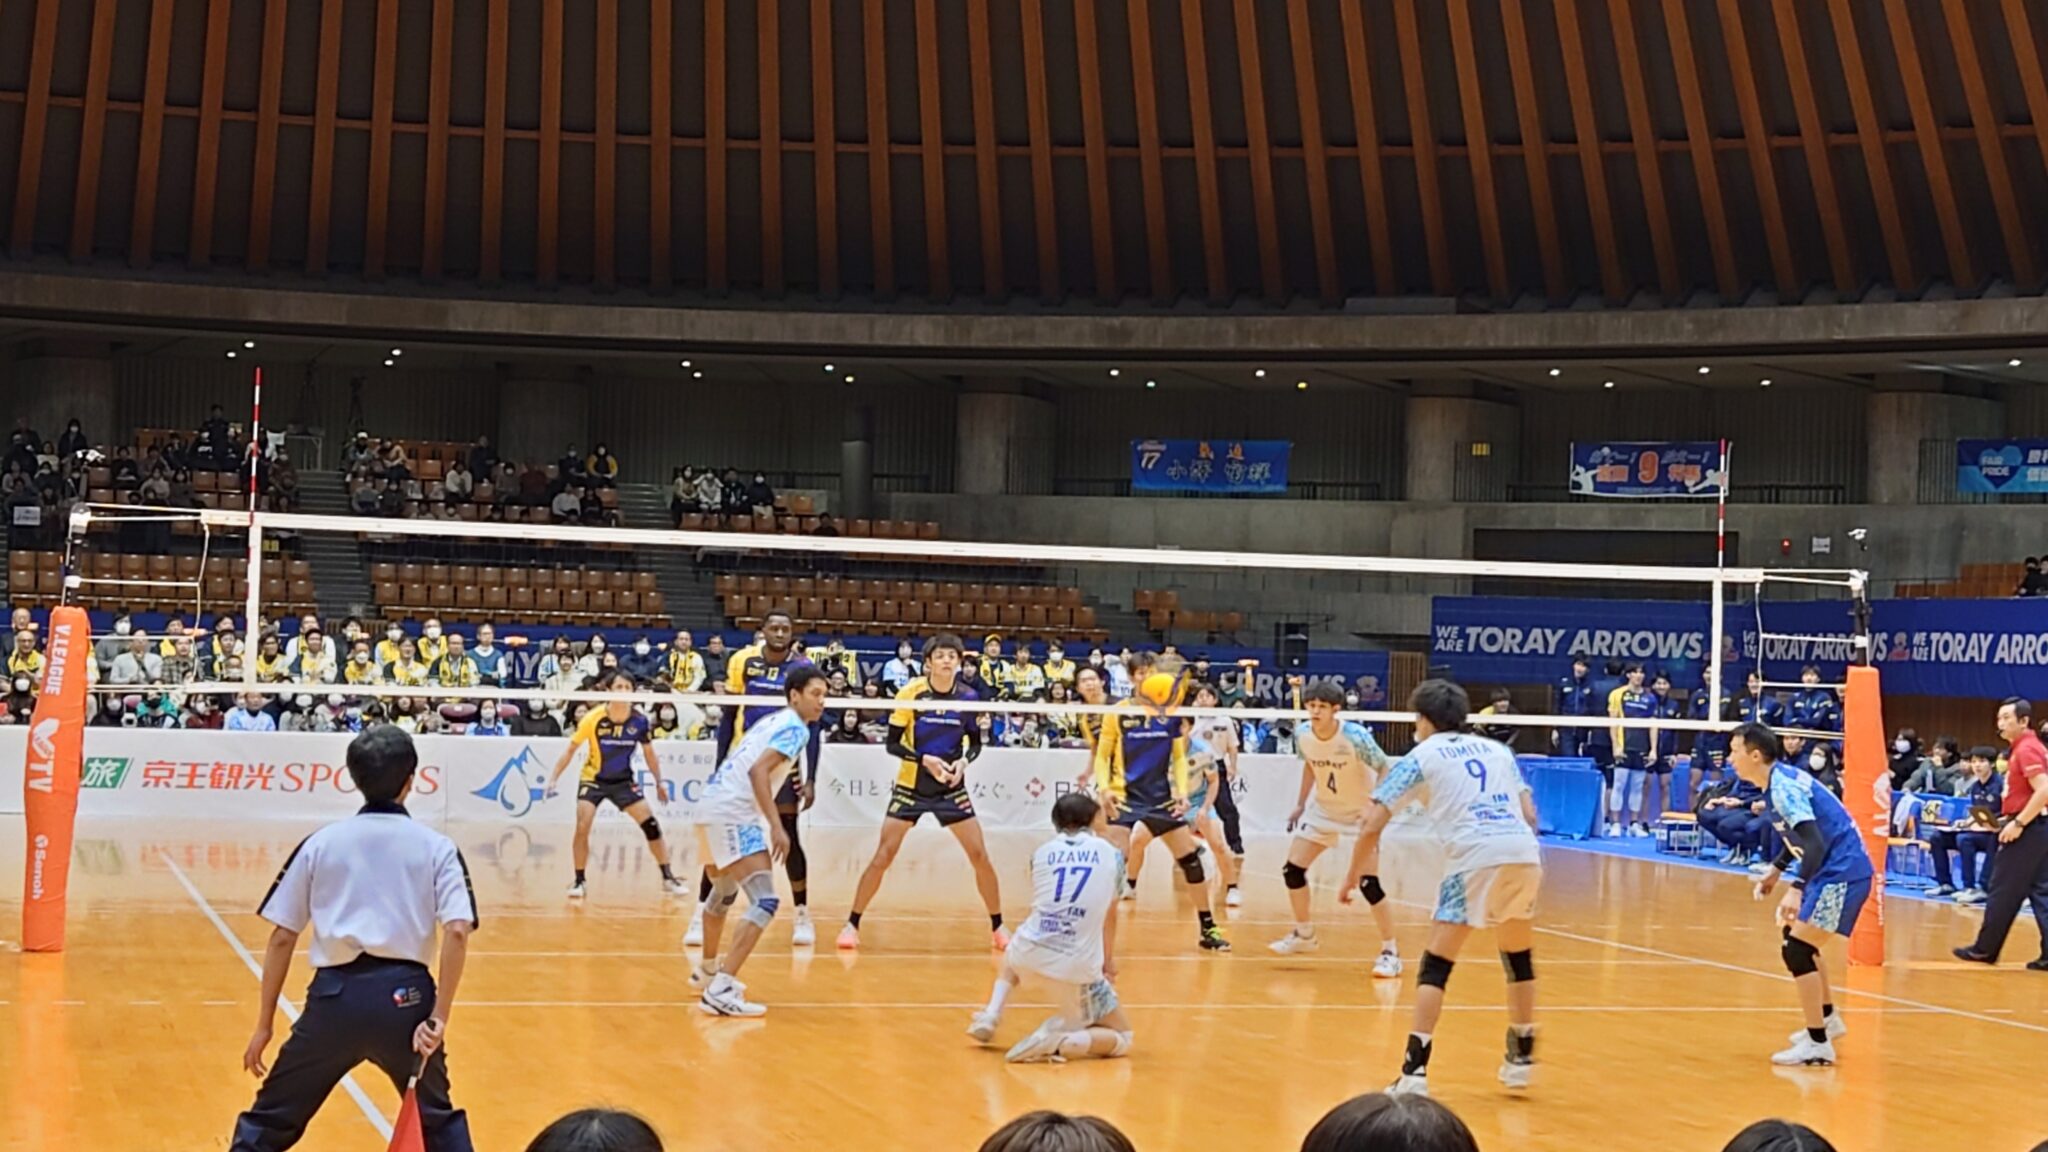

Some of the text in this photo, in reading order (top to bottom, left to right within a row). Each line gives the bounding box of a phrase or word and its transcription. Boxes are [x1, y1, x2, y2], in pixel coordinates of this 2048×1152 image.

[1140, 452, 1161, 469] 17
[1638, 451, 1659, 484] 9
[1434, 638, 1465, 652] ARE
[1435, 625, 1459, 639] WE
[1465, 626, 1705, 660] TORAY ARROWS
[1762, 632, 1809, 661] ORAY
[1930, 631, 1992, 664] TORAY
[45, 623, 72, 696] V.LEAGUE
[1436, 742, 1492, 760] TOMITA
[83, 757, 120, 789] 旅
[141, 759, 440, 795] 京王観光 SPOS
[1326, 771, 1338, 795] 4
[1464, 758, 1487, 793] 9
[1047, 849, 1100, 866] OZAWA
[32, 849, 46, 901] Senoh
[1052, 866, 1093, 903] 17
